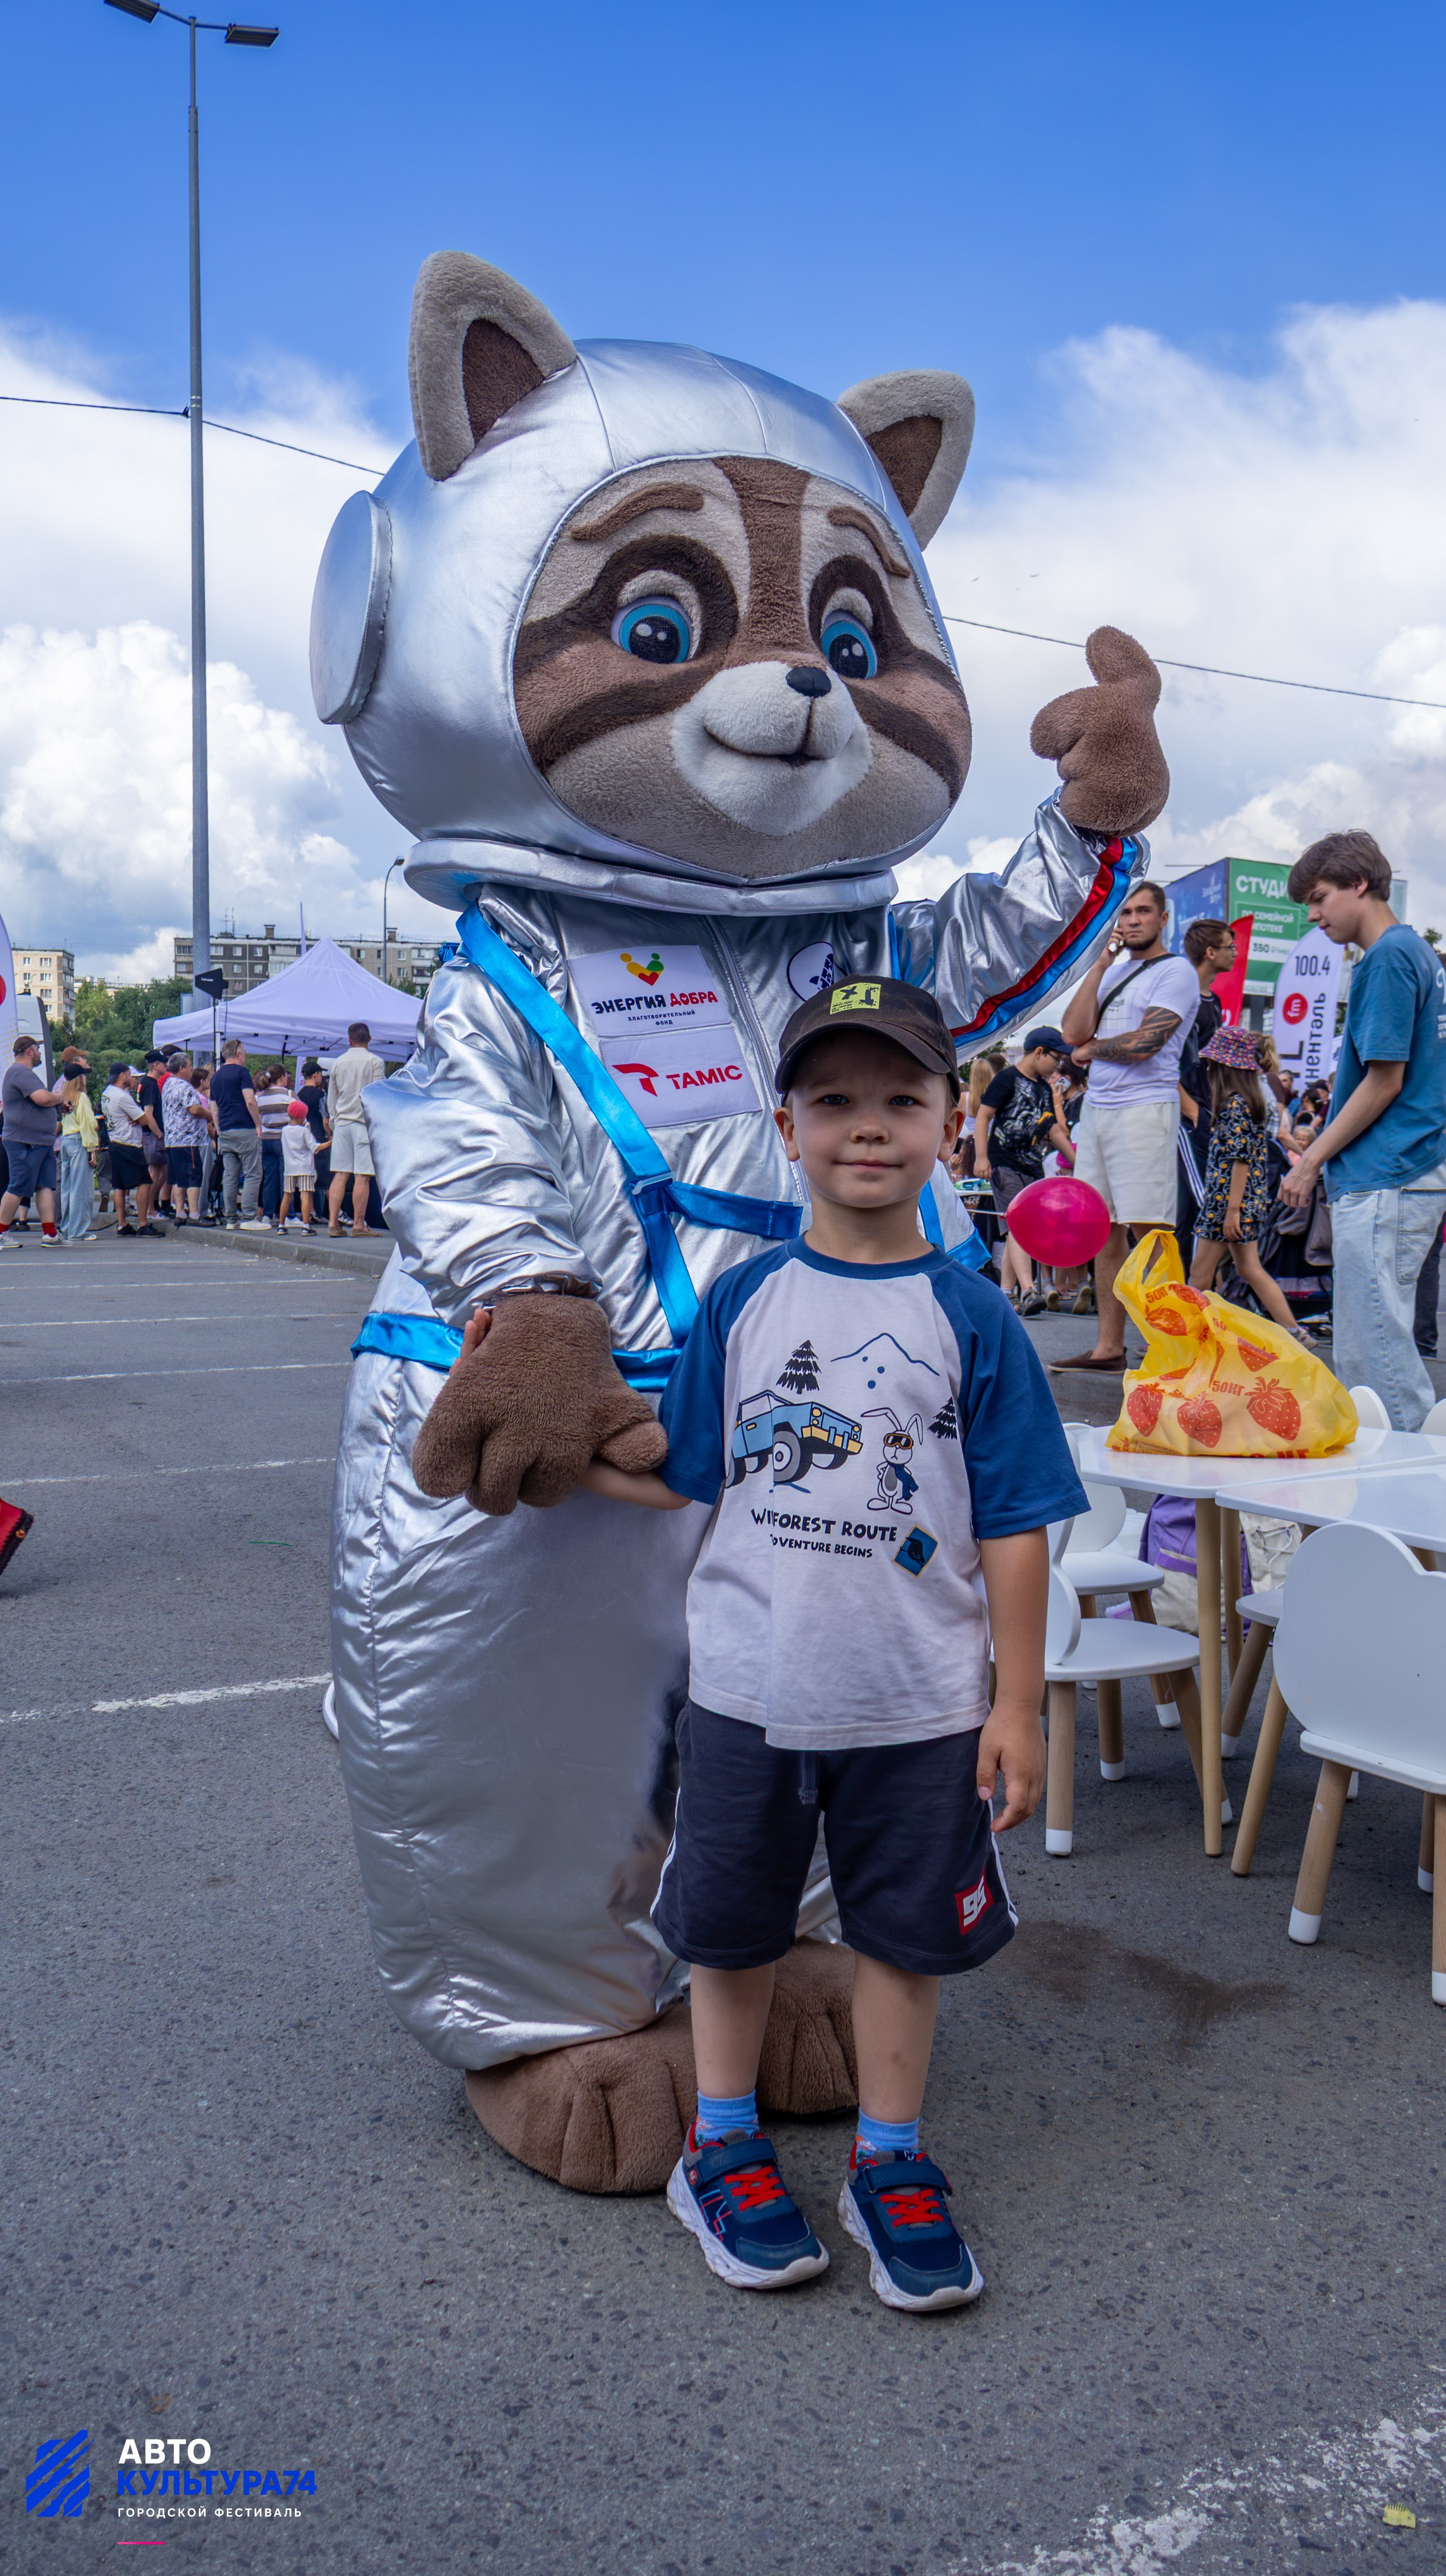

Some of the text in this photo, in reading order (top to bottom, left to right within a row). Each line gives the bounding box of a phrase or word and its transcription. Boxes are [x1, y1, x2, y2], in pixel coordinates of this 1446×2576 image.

[1254, 911, 1294, 924] СЕМЕЙНОЙ
[1295, 955, 1330, 976] 100.4
[591, 991, 718, 1014] ЭНЕРГИЯ ДОБРА
[1287, 998, 1301, 1018] fm
[628, 1009, 696, 1021] БЛАГОТВОРИТЕЛЬНЫЙ
[666, 1065, 743, 1089] TAMIC
[842, 1521, 898, 1542] ROUTE
[834, 1545, 873, 1558] BEGINS
